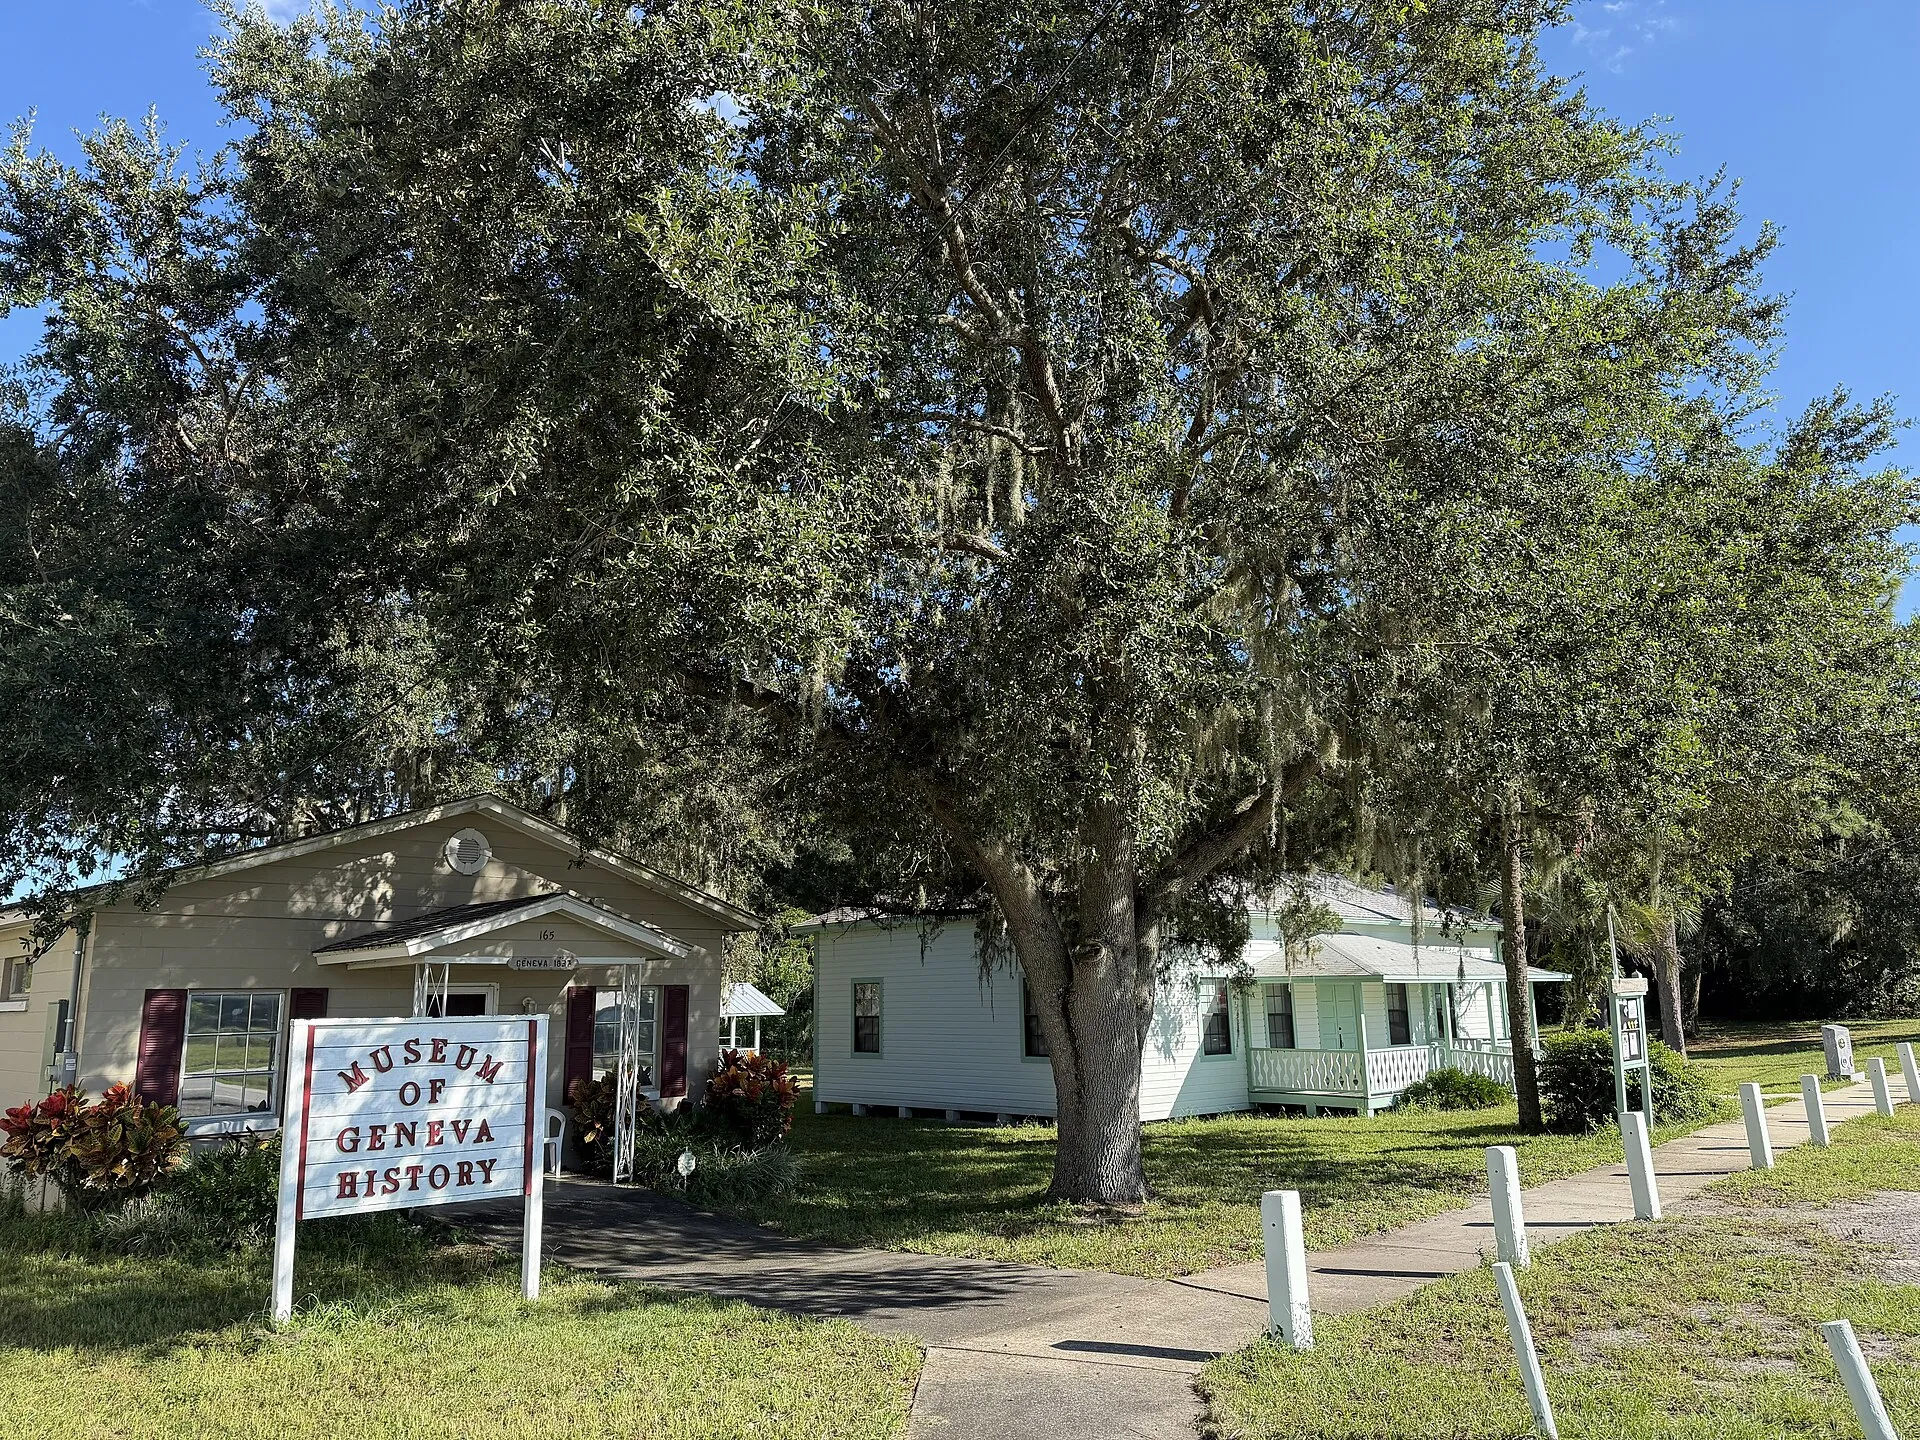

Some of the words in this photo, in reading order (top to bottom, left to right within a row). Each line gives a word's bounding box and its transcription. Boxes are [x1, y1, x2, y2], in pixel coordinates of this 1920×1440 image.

[539, 930, 555, 940] 165
[516, 959, 548, 967] GENEVA
[338, 1038, 504, 1095] MUSEUM
[399, 1079, 446, 1106] OF
[337, 1118, 495, 1153] GENEVA
[337, 1158, 498, 1199] HISTORY
